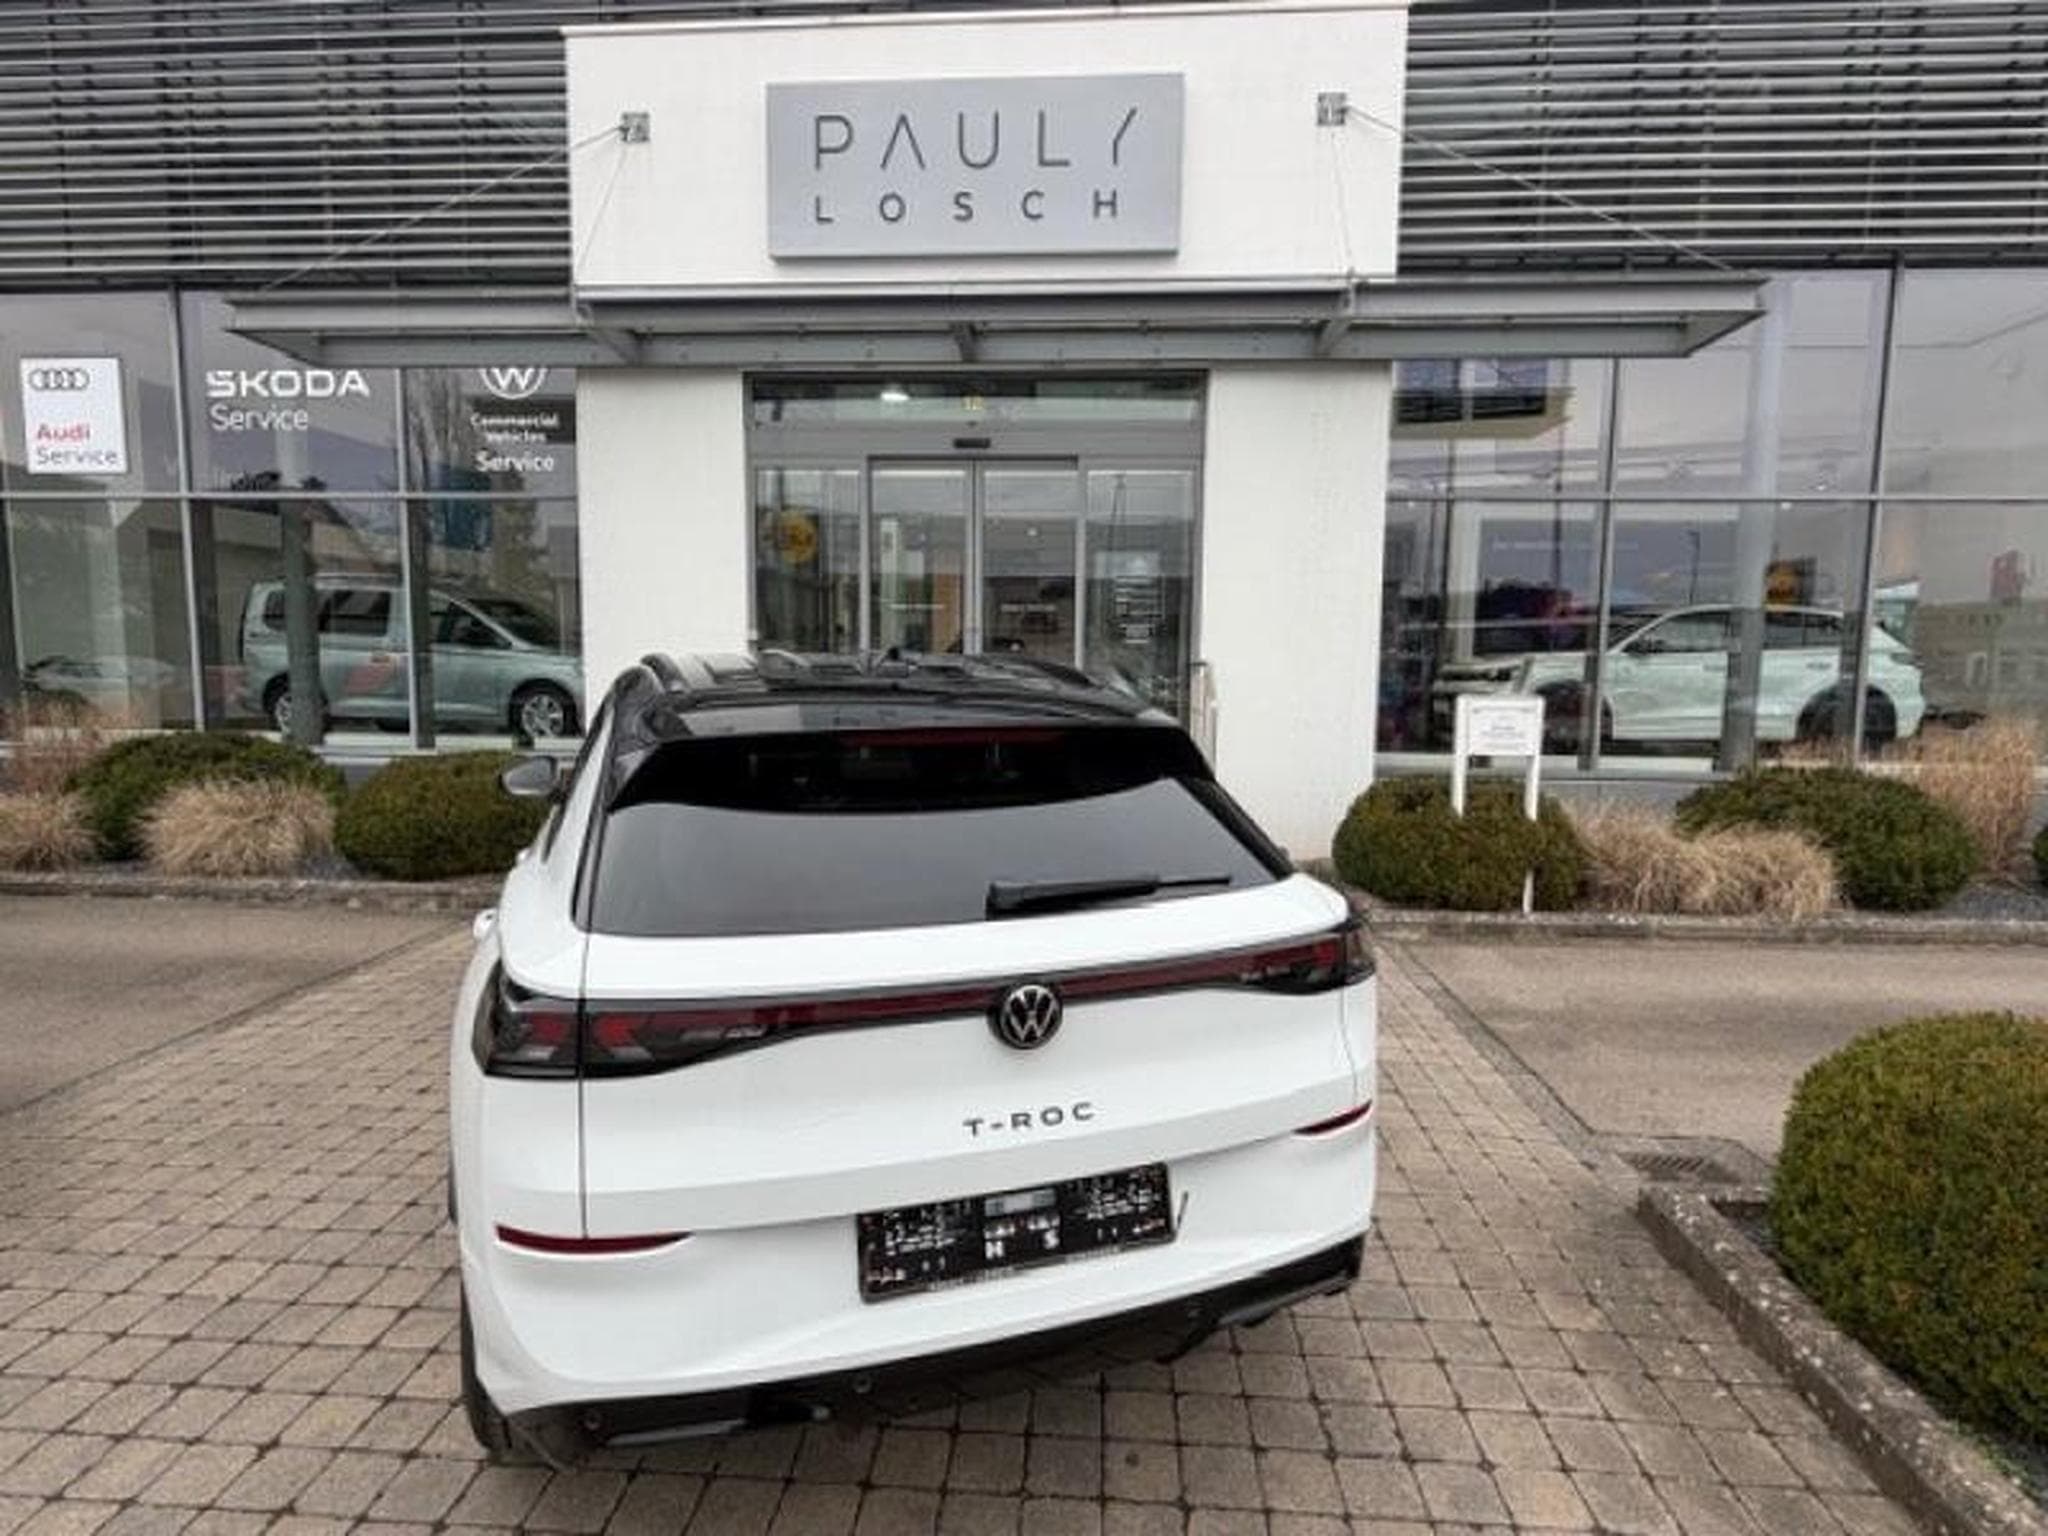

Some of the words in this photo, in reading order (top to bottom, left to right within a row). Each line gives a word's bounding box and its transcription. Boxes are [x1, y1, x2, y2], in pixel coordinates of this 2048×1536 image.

[814, 107, 1138, 171] PAULY
[814, 189, 1118, 225] LOSCH
[210, 401, 310, 431] Service
[37, 423, 91, 441] Audi
[37, 447, 119, 465] Service
[475, 451, 555, 472] Service
[962, 1101, 1096, 1137] T-ROC
